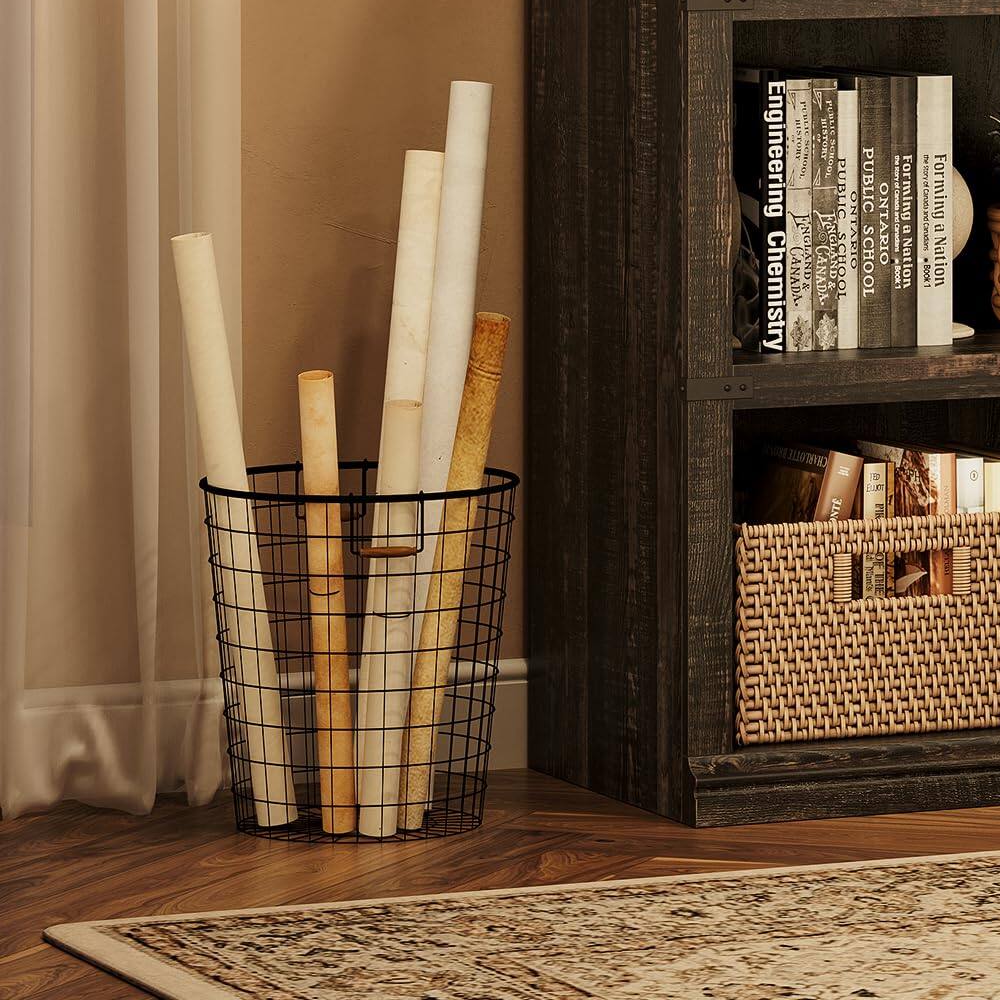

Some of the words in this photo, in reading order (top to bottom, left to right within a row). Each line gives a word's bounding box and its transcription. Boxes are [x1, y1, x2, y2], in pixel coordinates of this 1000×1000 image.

[763, 80, 786, 218] Engineering
[821, 118, 829, 161] HISTORY
[825, 100, 836, 136] PUBLIC
[825, 138, 836, 178] SCHOOL
[838, 158, 847, 220] PUBLIC
[862, 146, 874, 213] PUBLIC
[901, 154, 913, 221] Forming
[922, 165, 930, 180] Story
[931, 153, 948, 220] Forming
[850, 190, 858, 270] ONTARIO
[879, 182, 889, 265] ONTARIO
[902, 224, 912, 234] a
[934, 223, 946, 233] a
[763, 230, 786, 351] Chemistry
[837, 231, 847, 301] SCHOOL
[862, 224, 875, 298] SCHOOL
[902, 237, 913, 289] Nation
[923, 264, 931, 283] Book
[934, 236, 948, 288] Nation
